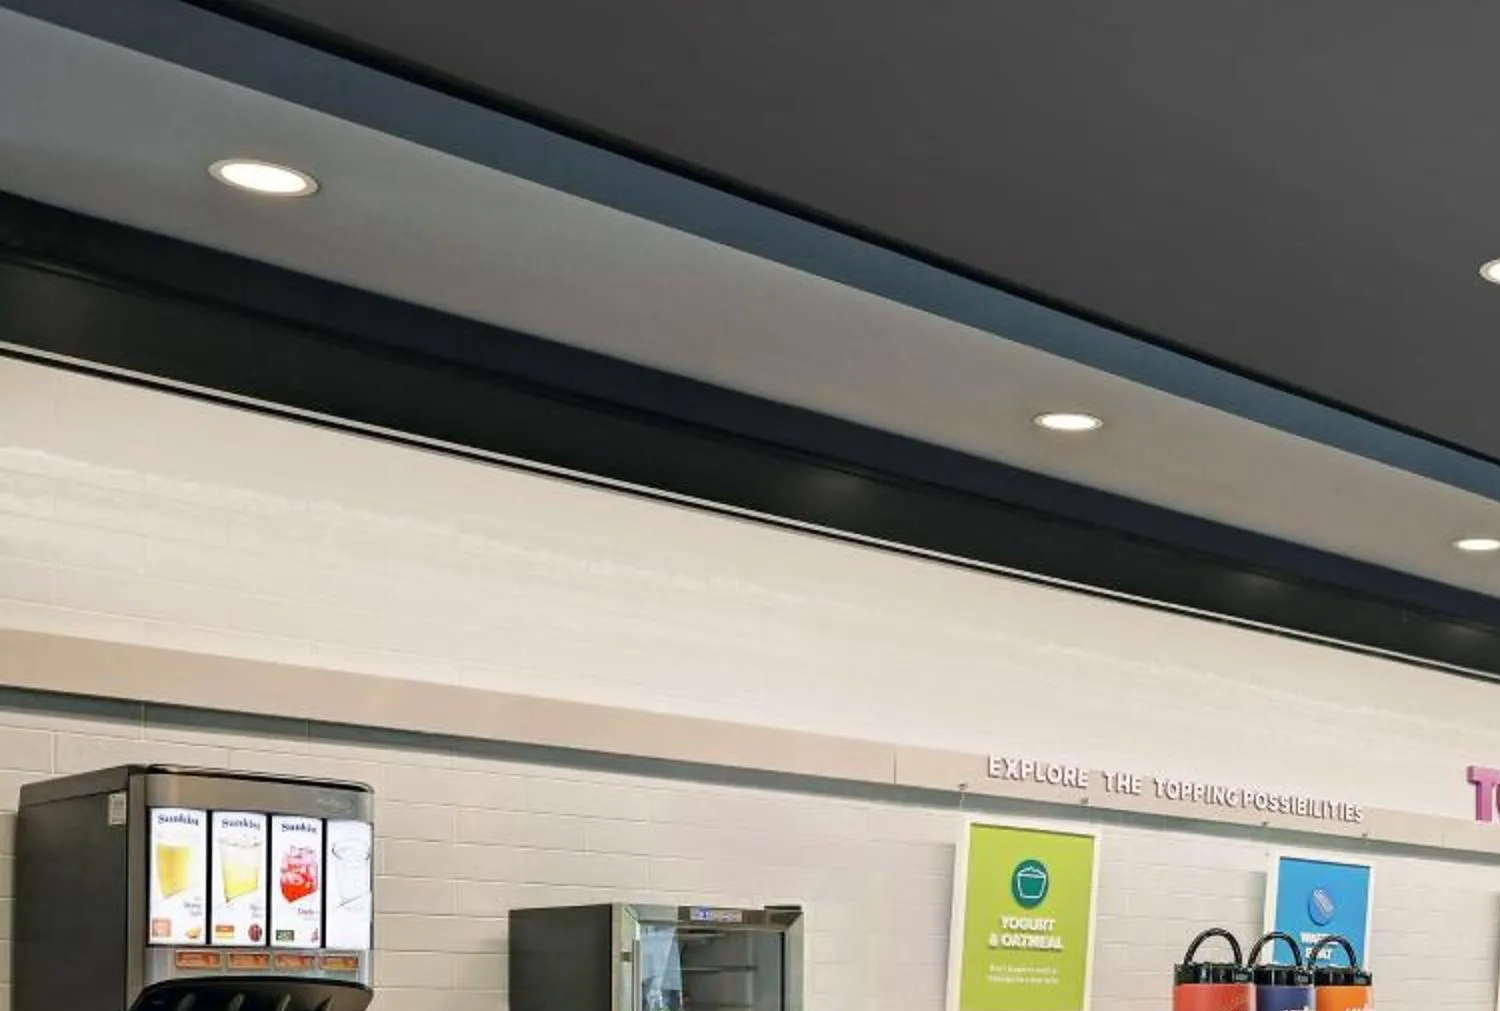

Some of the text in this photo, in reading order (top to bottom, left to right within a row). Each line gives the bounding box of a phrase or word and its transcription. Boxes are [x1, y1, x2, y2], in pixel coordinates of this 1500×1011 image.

[987, 755, 1364, 823] EXPLORE THE TOPPING POSSIBILITIES
[1000, 915, 1057, 932] YOGURT
[1001, 932, 1064, 950] OATMEAL
